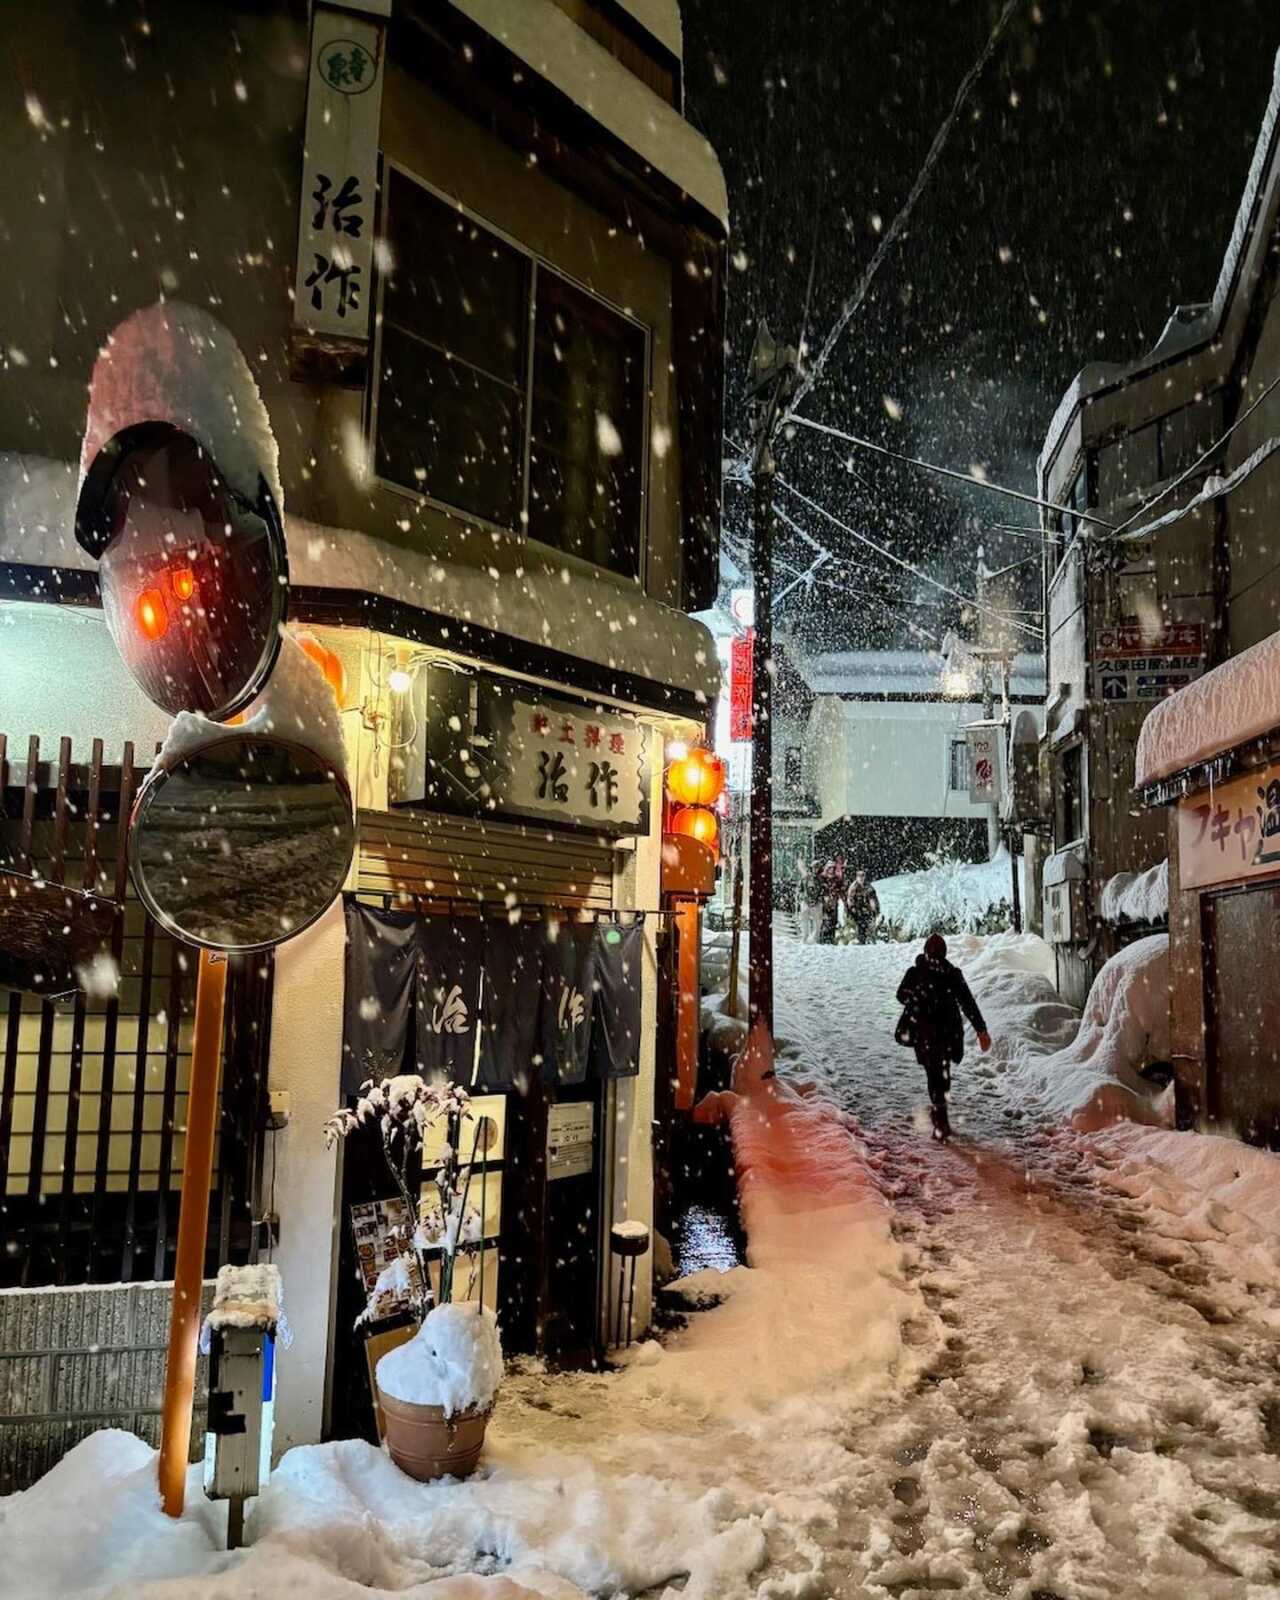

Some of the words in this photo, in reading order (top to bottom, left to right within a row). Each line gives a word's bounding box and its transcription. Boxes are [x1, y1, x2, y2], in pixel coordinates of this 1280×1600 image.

[305, 174, 364, 318] 治作
[536, 751, 619, 813] 治作
[432, 985, 470, 1034] 治
